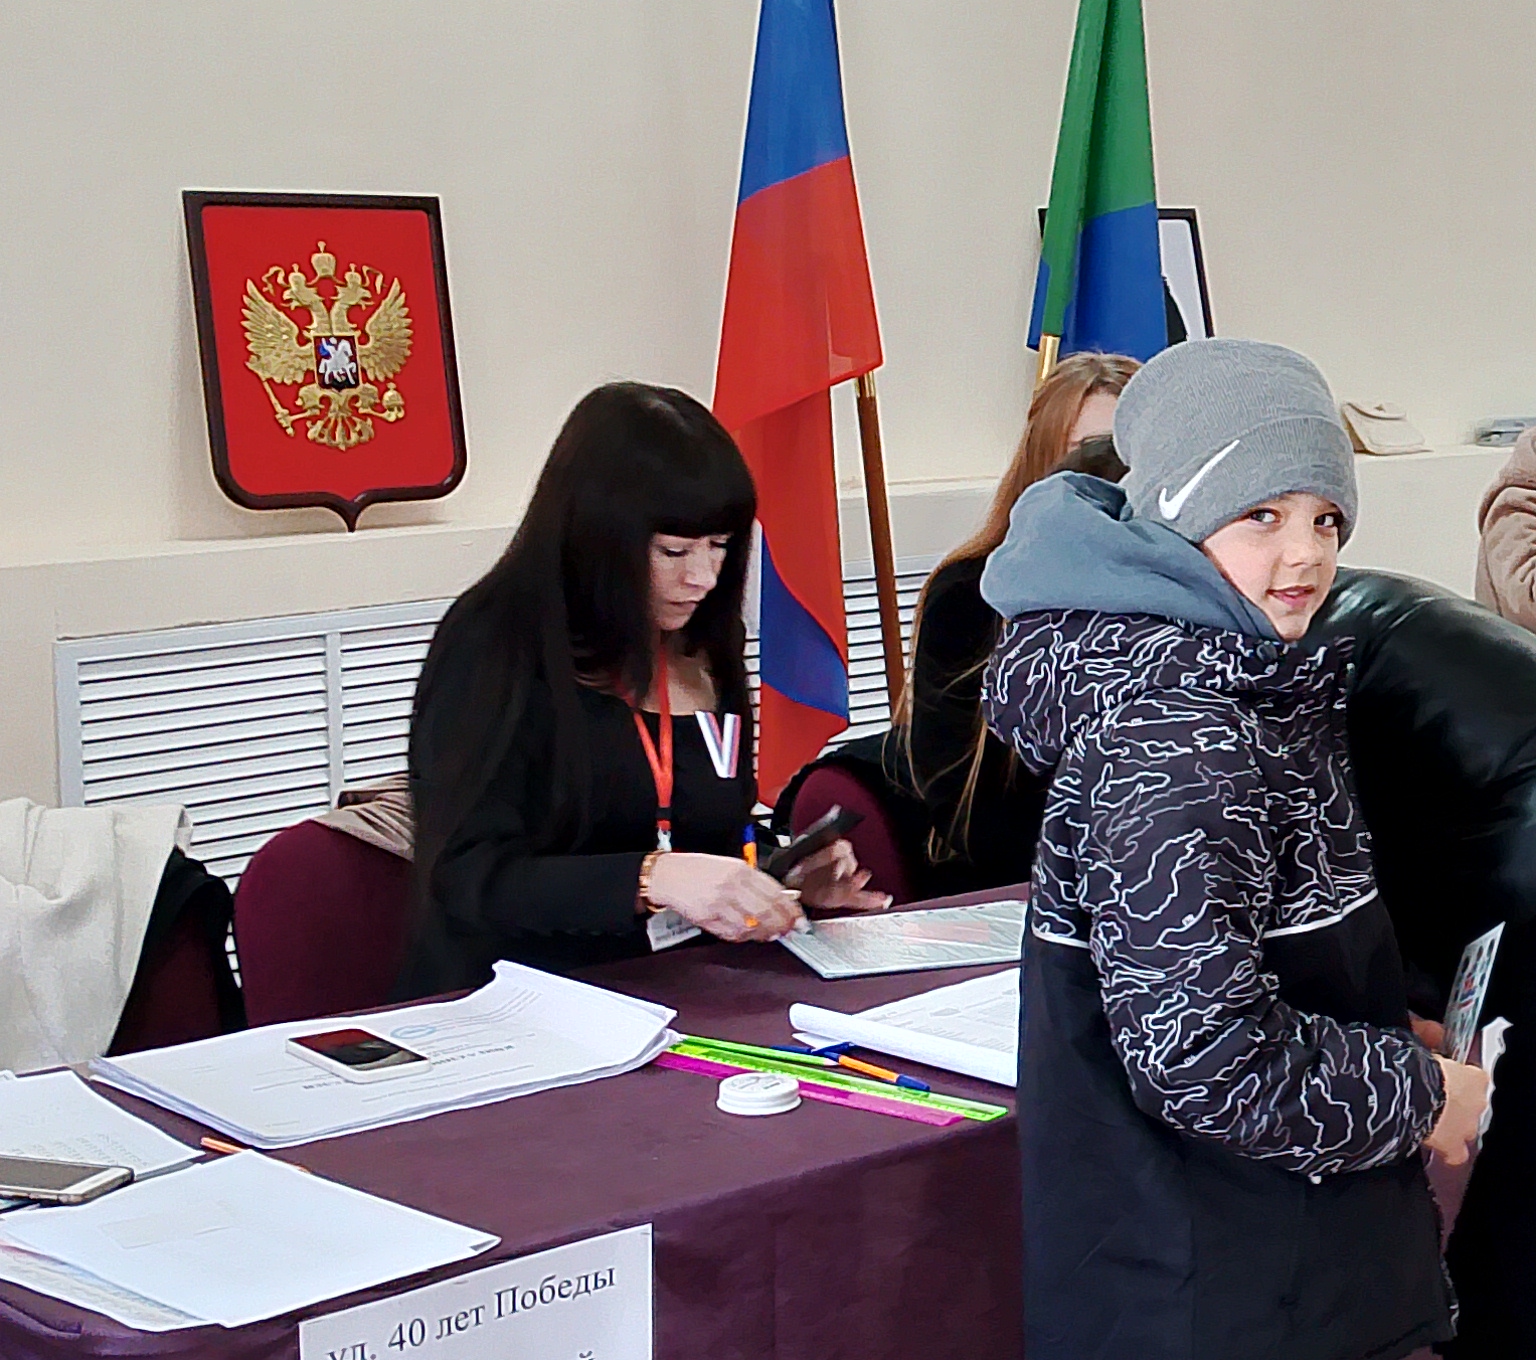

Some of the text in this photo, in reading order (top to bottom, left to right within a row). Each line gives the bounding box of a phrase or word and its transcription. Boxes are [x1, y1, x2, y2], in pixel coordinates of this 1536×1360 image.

[387, 1317, 426, 1352] 40
[435, 1304, 486, 1340] лет
[493, 1266, 617, 1320] Победы
